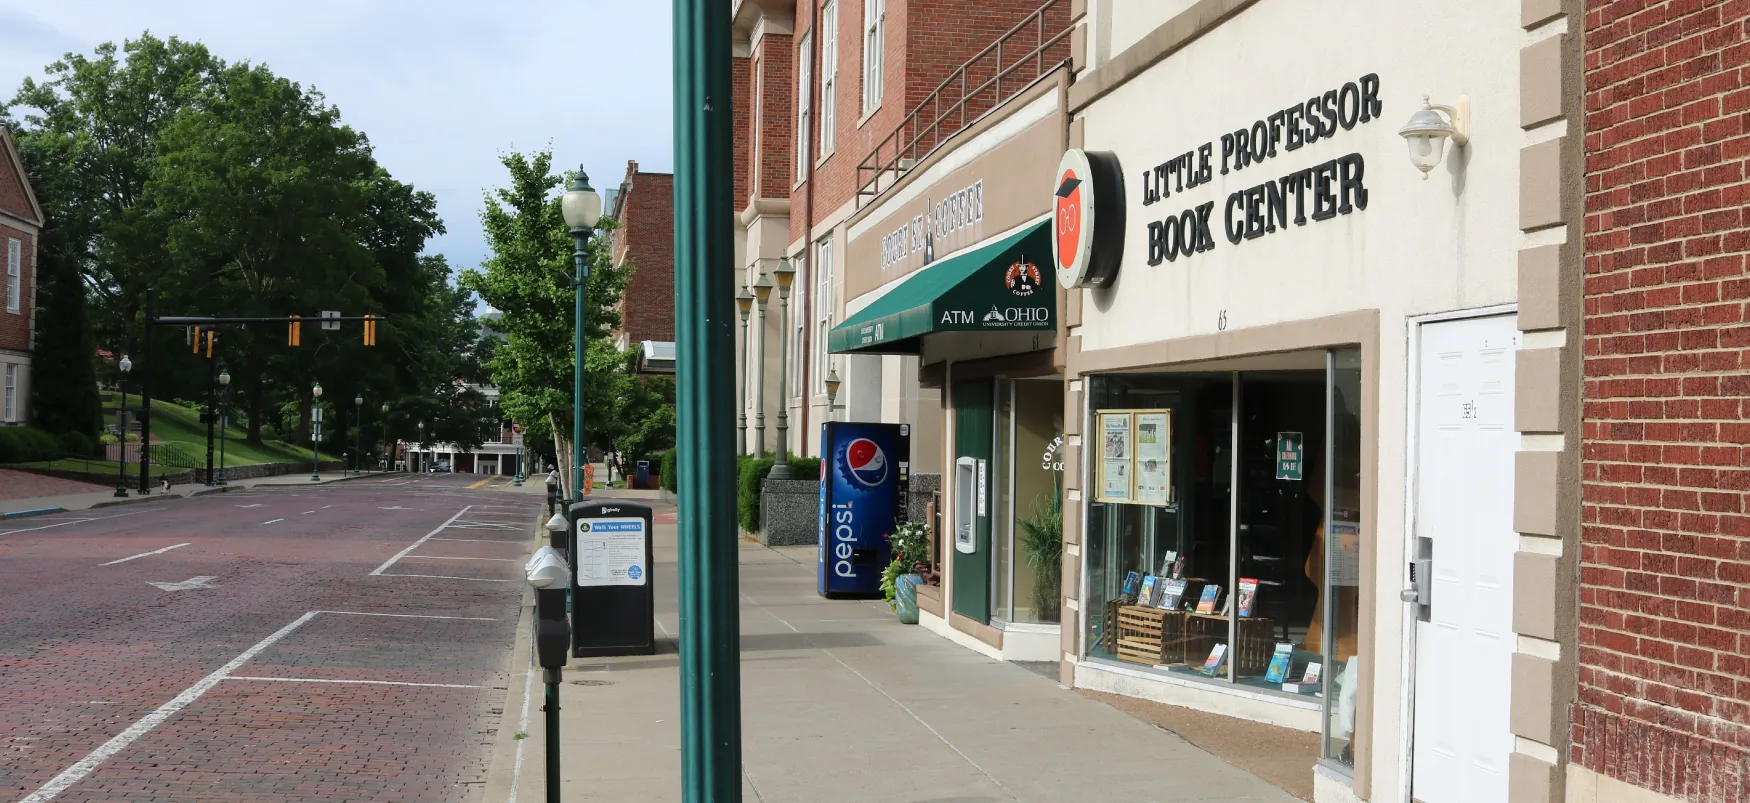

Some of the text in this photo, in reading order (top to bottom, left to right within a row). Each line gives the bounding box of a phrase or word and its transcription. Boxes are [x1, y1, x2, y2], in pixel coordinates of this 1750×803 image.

[1142, 72, 1382, 206] LITTLE PROFESSOR
[881, 222, 909, 270] COURT
[935, 178, 983, 241] COFFEE
[1146, 152, 1368, 267] BOOK CENTER
[1012, 289, 1034, 297] COFFEE
[941, 310, 974, 324] ATM
[1005, 307, 1049, 322] OHIO
[1218, 309, 1227, 331] 65
[1032, 332, 1039, 351] 61
[1042, 433, 1065, 470] COUR
[832, 503, 858, 578] pepsi
